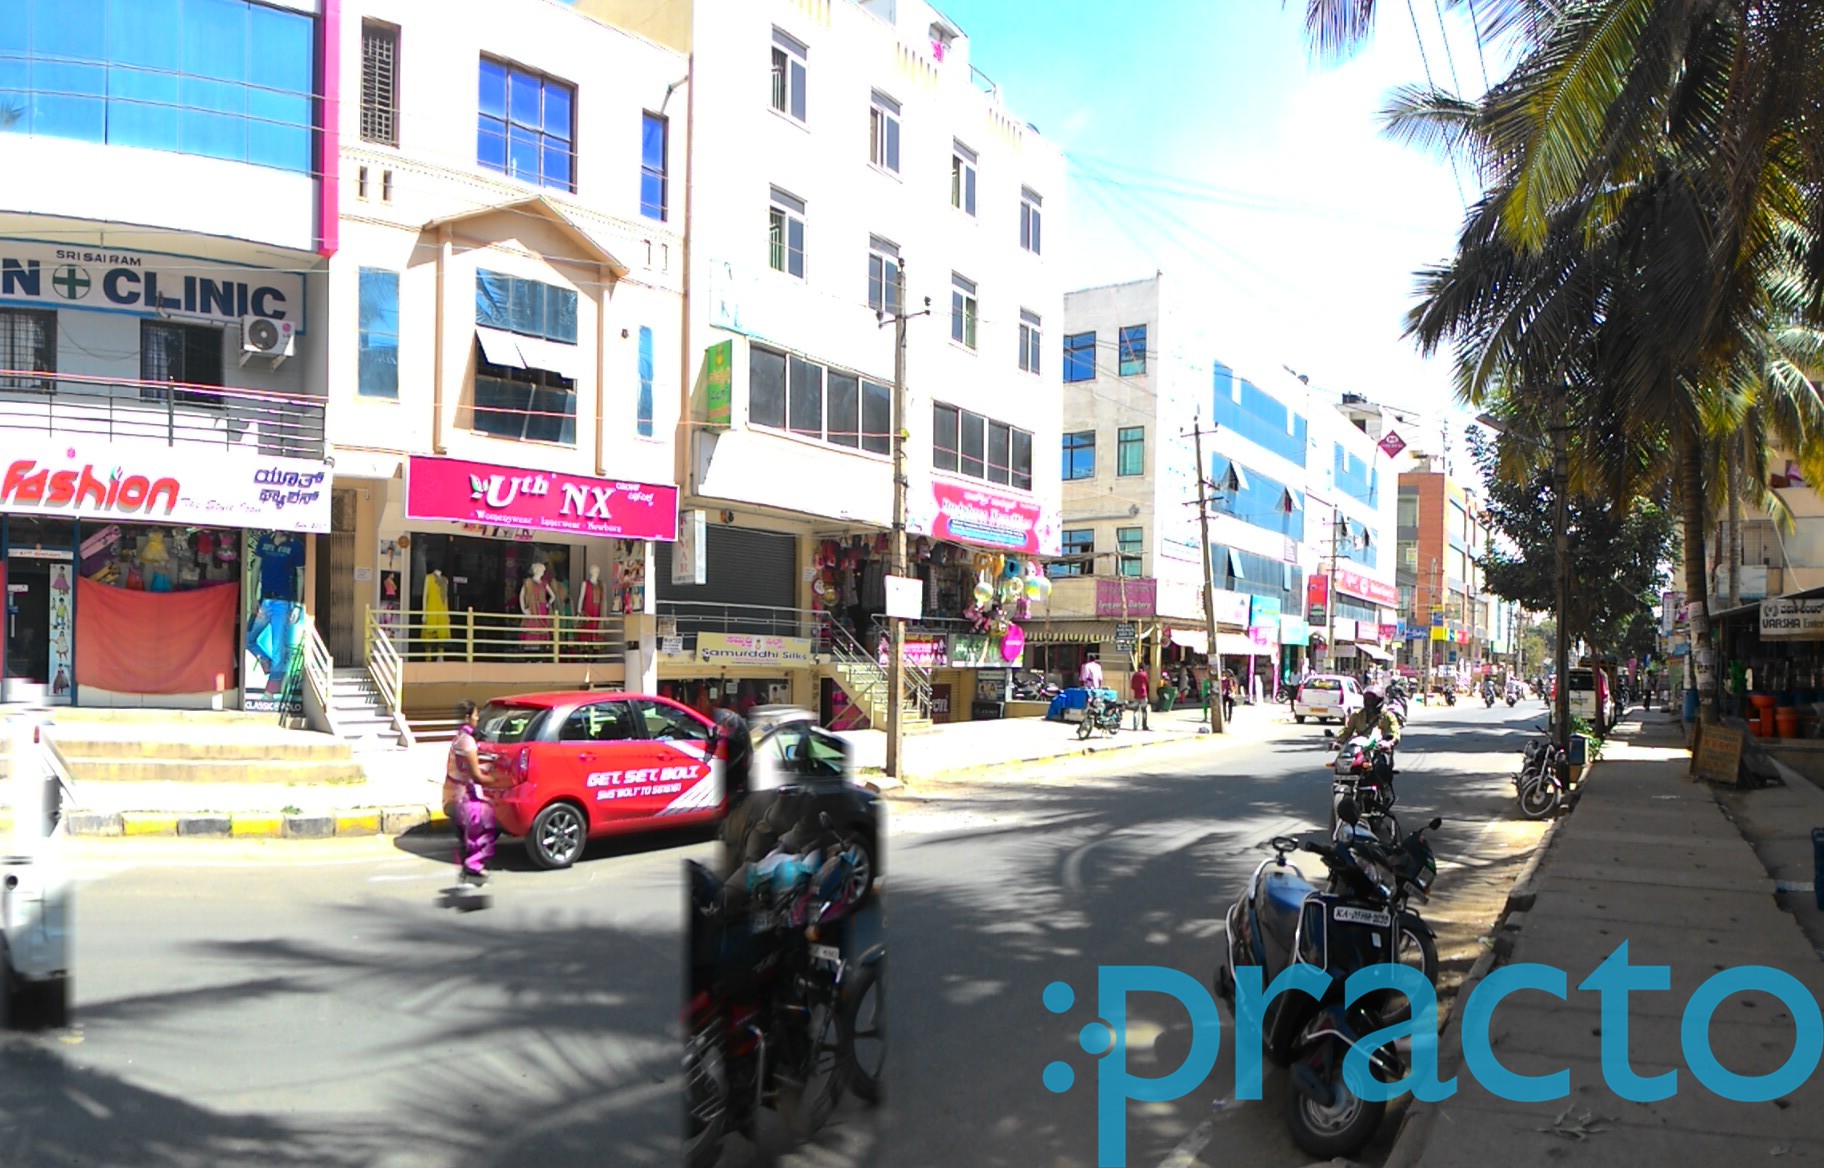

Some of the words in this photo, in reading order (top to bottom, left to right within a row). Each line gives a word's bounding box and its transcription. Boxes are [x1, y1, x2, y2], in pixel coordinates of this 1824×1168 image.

[109, 254, 142, 267] RAM
[103, 267, 287, 320] CLINIC
[0, 460, 181, 515] Fashion
[486, 473, 550, 508] Uth
[559, 484, 617, 519] NX
[782, 651, 808, 660] Silks
